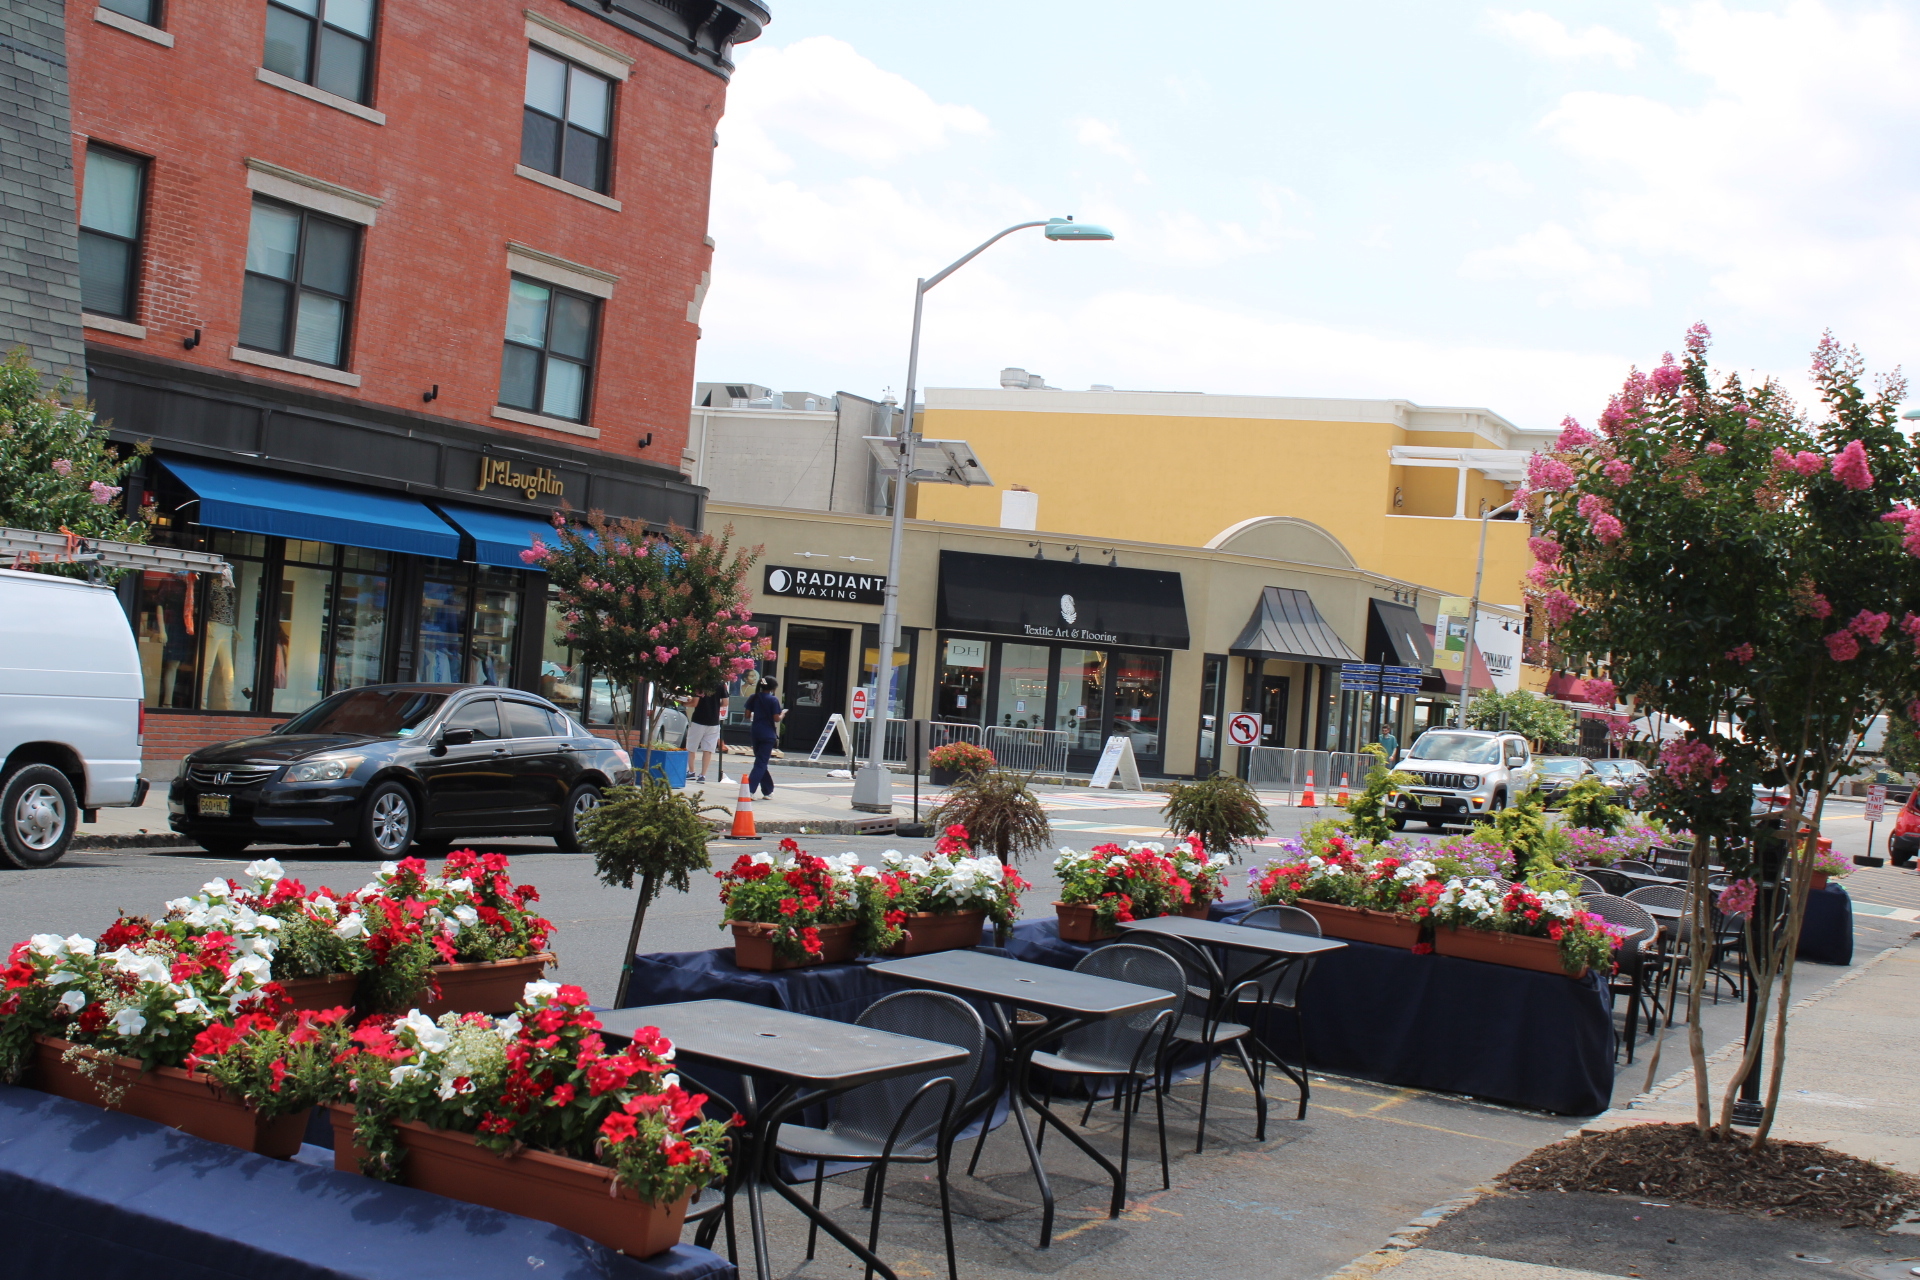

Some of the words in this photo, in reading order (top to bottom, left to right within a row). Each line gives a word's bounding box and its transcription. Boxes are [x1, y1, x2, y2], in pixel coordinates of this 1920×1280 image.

[796, 570, 884, 591] RADIANT
[796, 586, 857, 600] WAXING
[1024, 624, 1053, 636] Textile
[1055, 627, 1069, 638] Art
[1071, 628, 1080, 639] &
[1081, 629, 1117, 644] Flooring
[953, 645, 979, 657] DH
